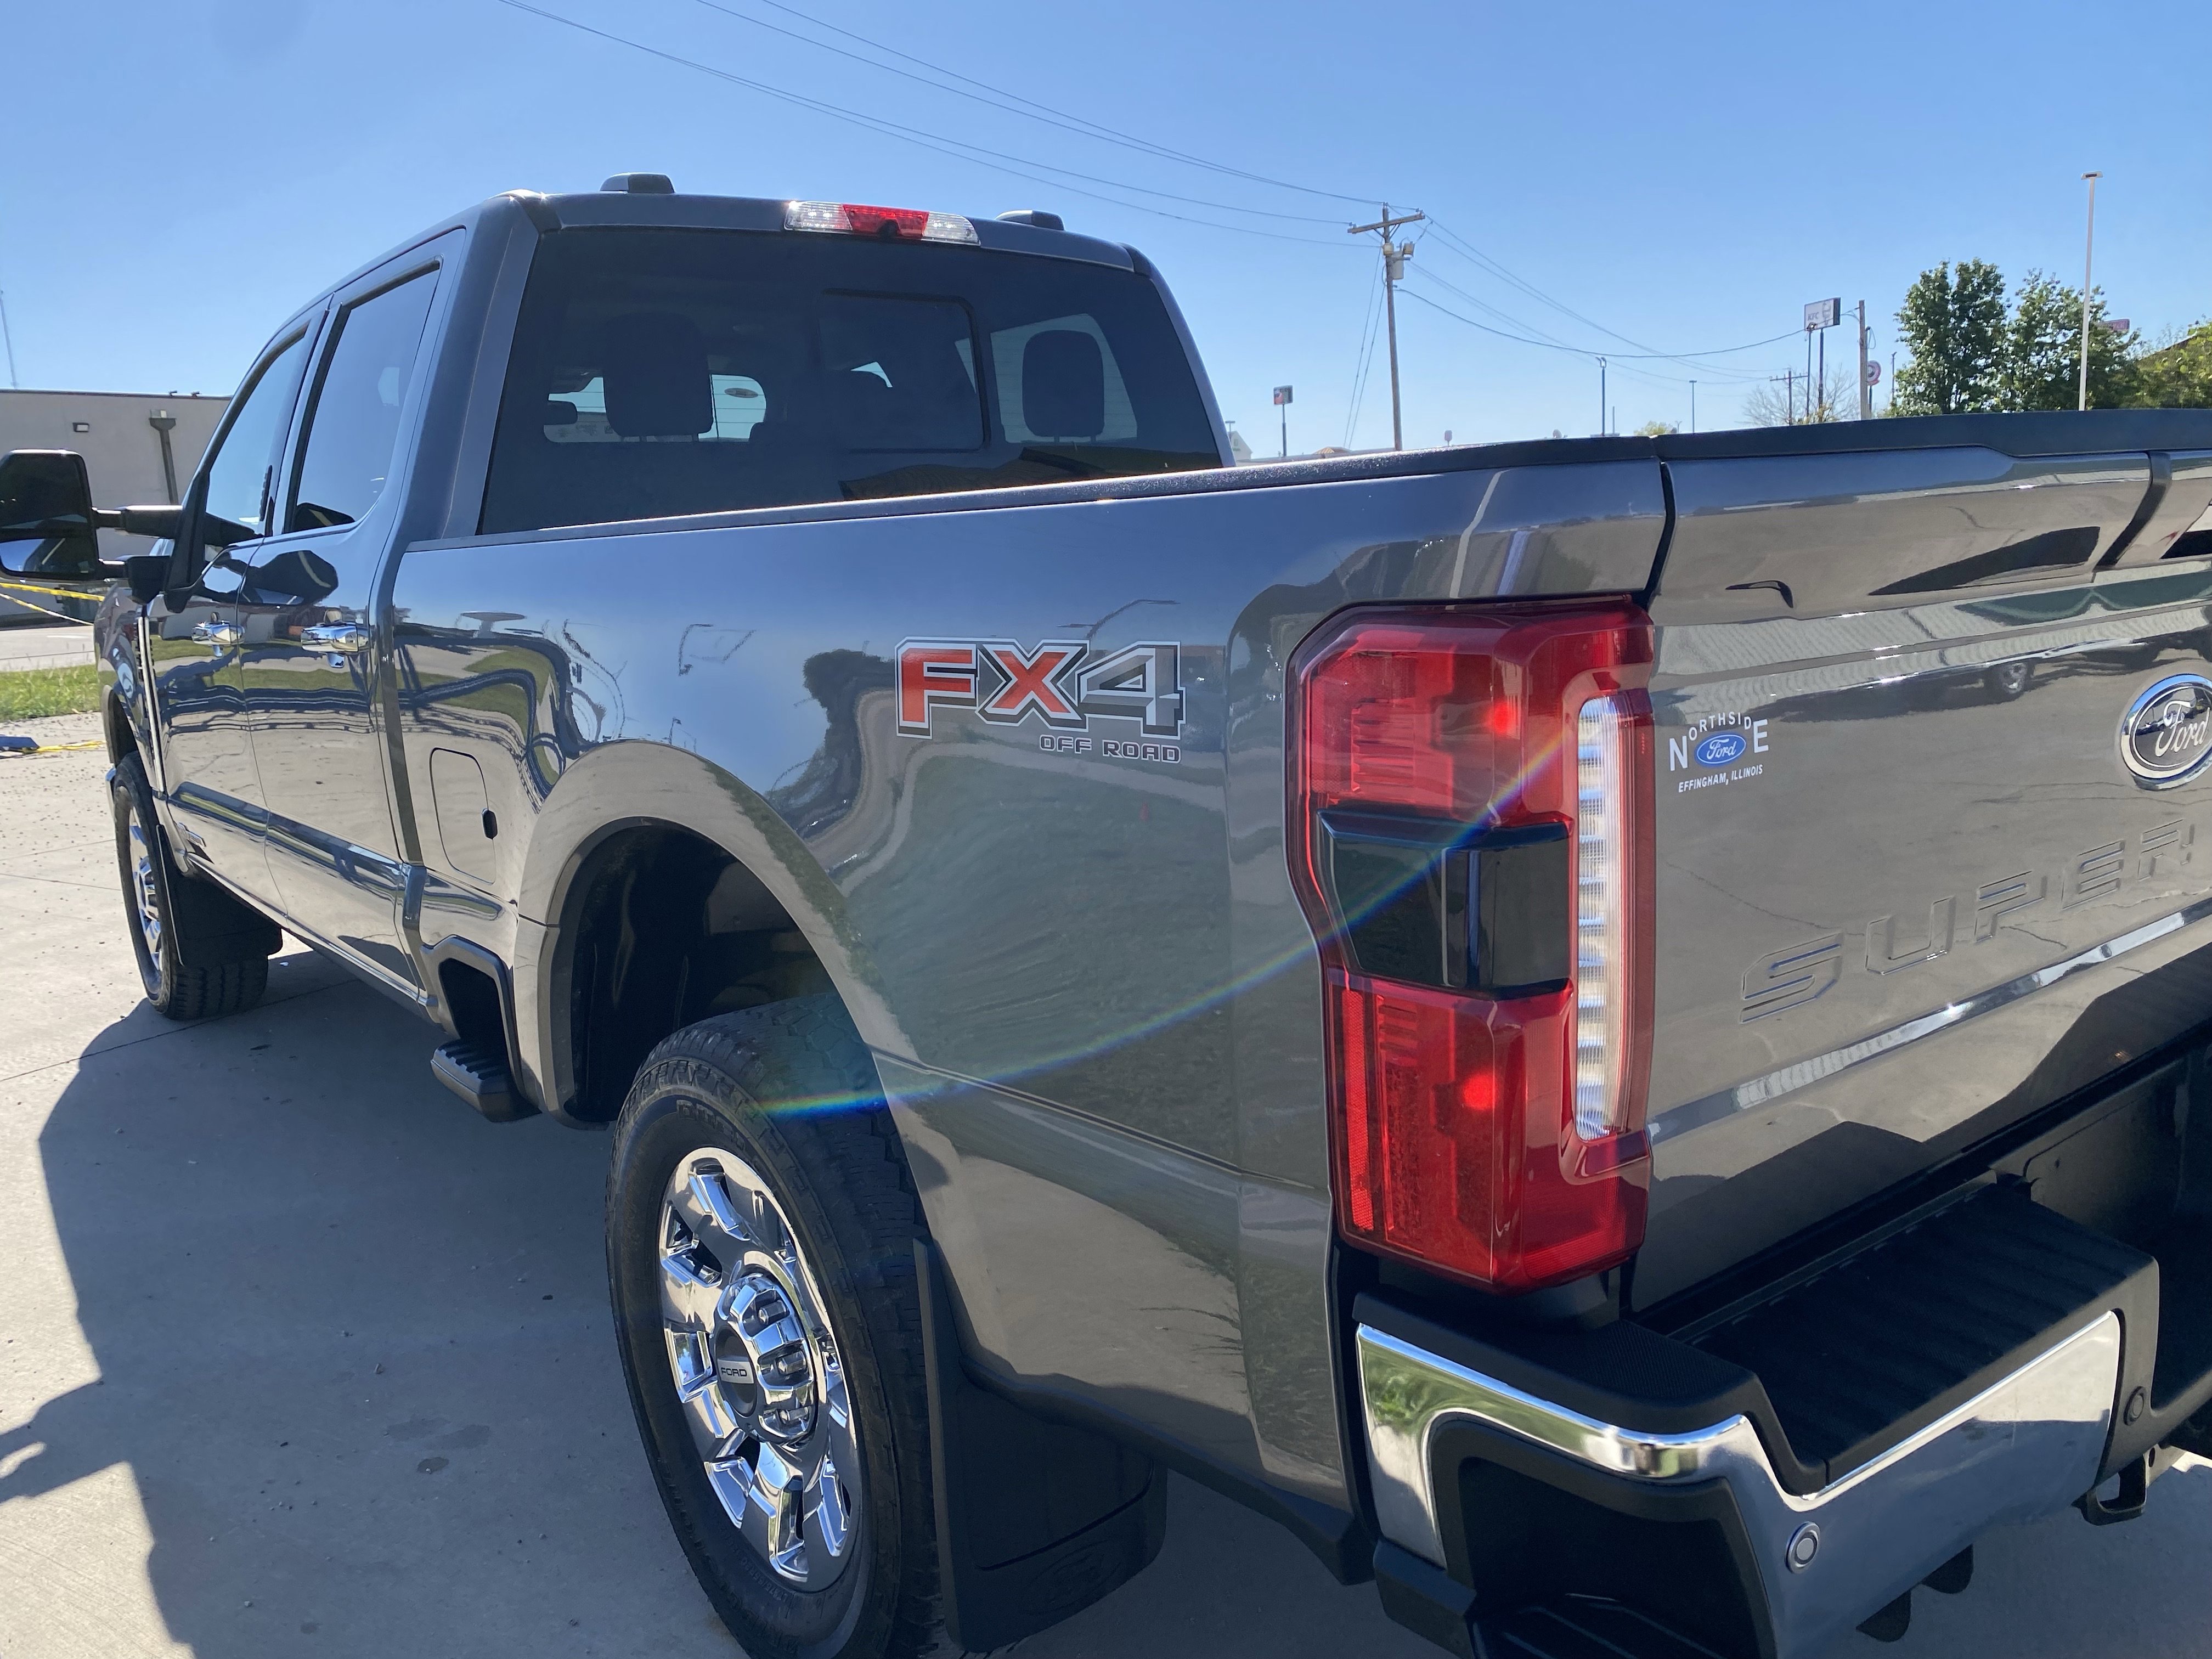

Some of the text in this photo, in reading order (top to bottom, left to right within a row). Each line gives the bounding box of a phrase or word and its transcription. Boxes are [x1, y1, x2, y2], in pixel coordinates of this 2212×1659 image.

[1808, 312, 1819, 320] KFC
[895, 636, 1186, 740] FX4
[1669, 712, 1769, 771] NORTHSIDE
[2155, 701, 2210, 757] Ford
[1040, 735, 1181, 763] OFF ROAD
[1707, 738, 1737, 760] Ford
[1678, 764, 1763, 793] EFFINGHAM, ILLINOIS
[1739, 819, 2195, 1024] SUPER
[721, 1367, 747, 1377] FORD
